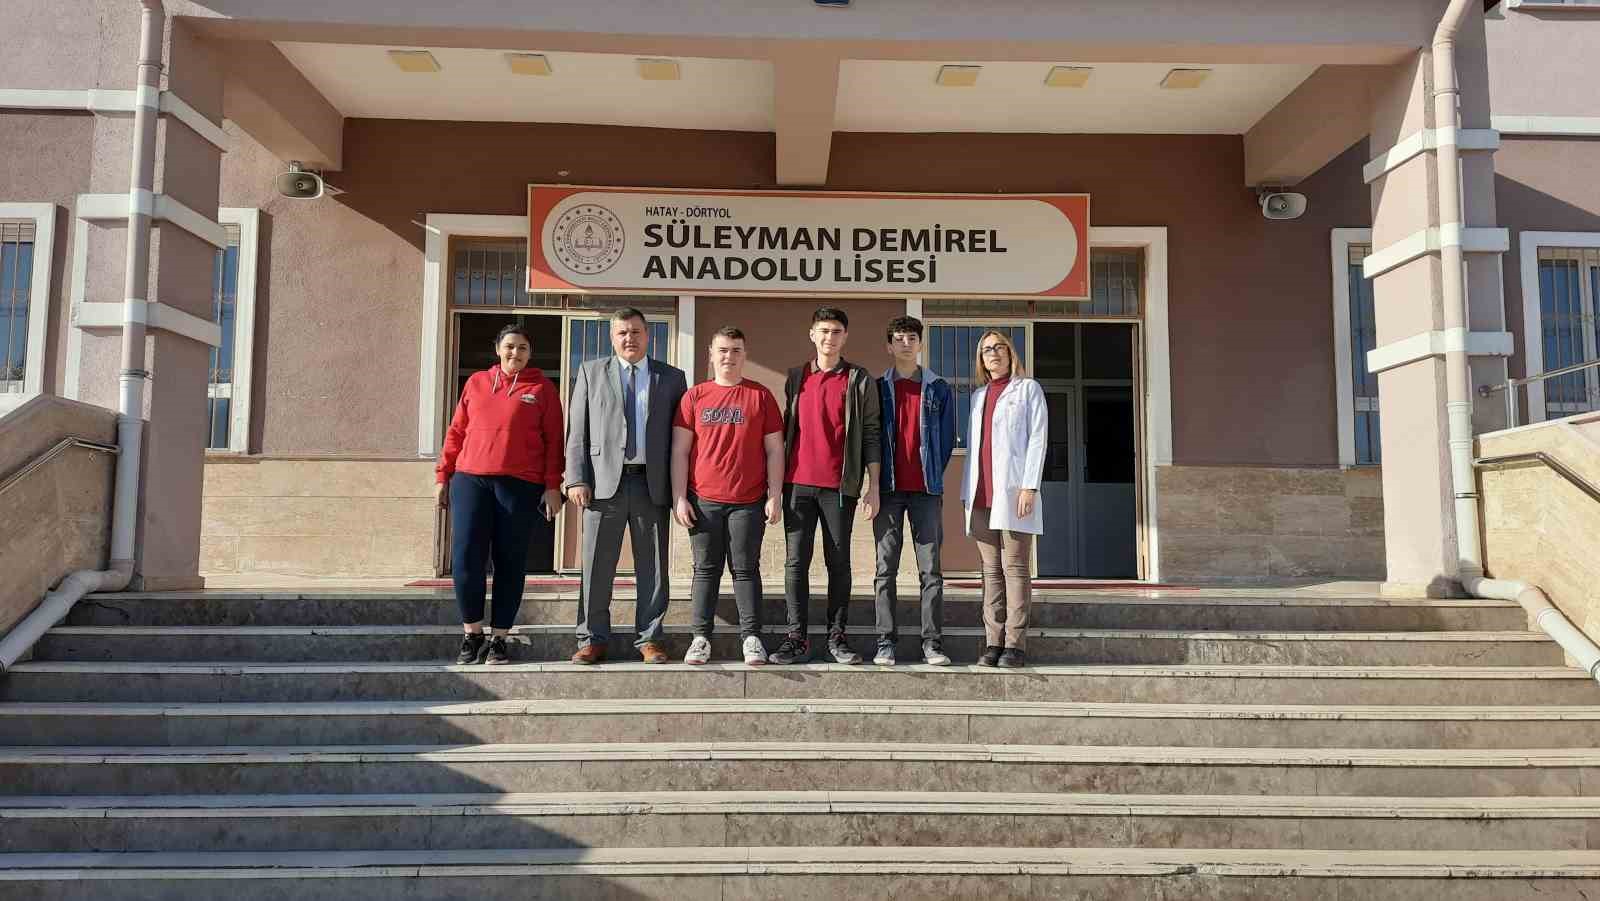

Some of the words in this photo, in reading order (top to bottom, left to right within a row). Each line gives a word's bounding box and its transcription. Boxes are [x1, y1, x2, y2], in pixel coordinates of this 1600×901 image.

[645, 206, 679, 217] HATAY
[686, 205, 732, 218] DÖRTYOL
[643, 218, 840, 251] SÜLEYMAN
[852, 223, 1008, 253] DEMİREL
[642, 255, 823, 282] ANADOLU
[834, 254, 937, 283] LİSESİ
